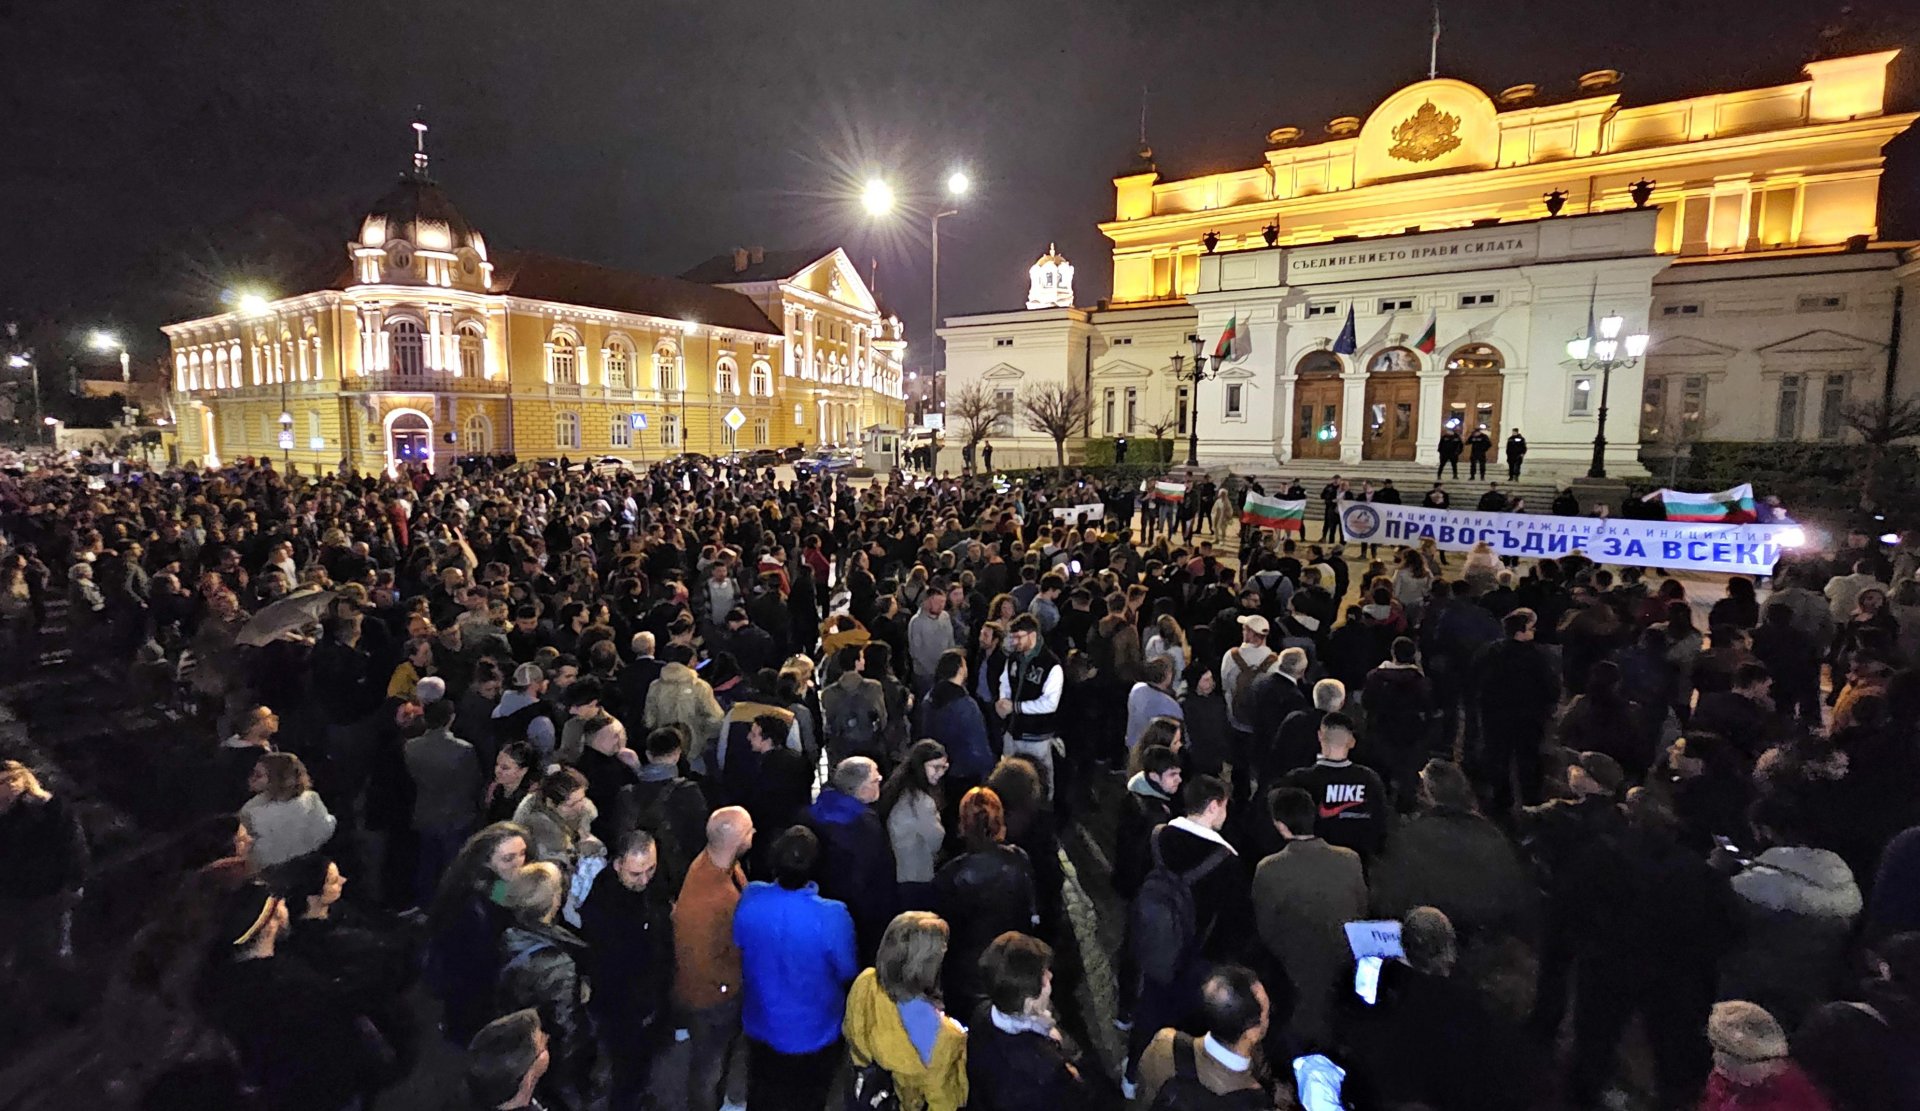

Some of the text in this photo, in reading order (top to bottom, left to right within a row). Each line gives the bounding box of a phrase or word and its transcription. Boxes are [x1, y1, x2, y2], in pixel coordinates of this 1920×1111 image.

[1293, 239, 1524, 269] СЪЕДИНЕНИЕТО ПРАВИ СИЛАТА
[1386, 510, 1493, 527] НАЦИОНАЛНА
[1506, 520, 1631, 536] ГРАЖДАНСКА
[1646, 529, 1782, 542] ИНИЦИАТИВ
[1385, 519, 1589, 554] ПРАВОСЪДИЕ
[1602, 537, 1647, 558] ЗА
[1662, 540, 1782, 566] ВСЕКИ
[1325, 784, 1366, 803] NIKE
